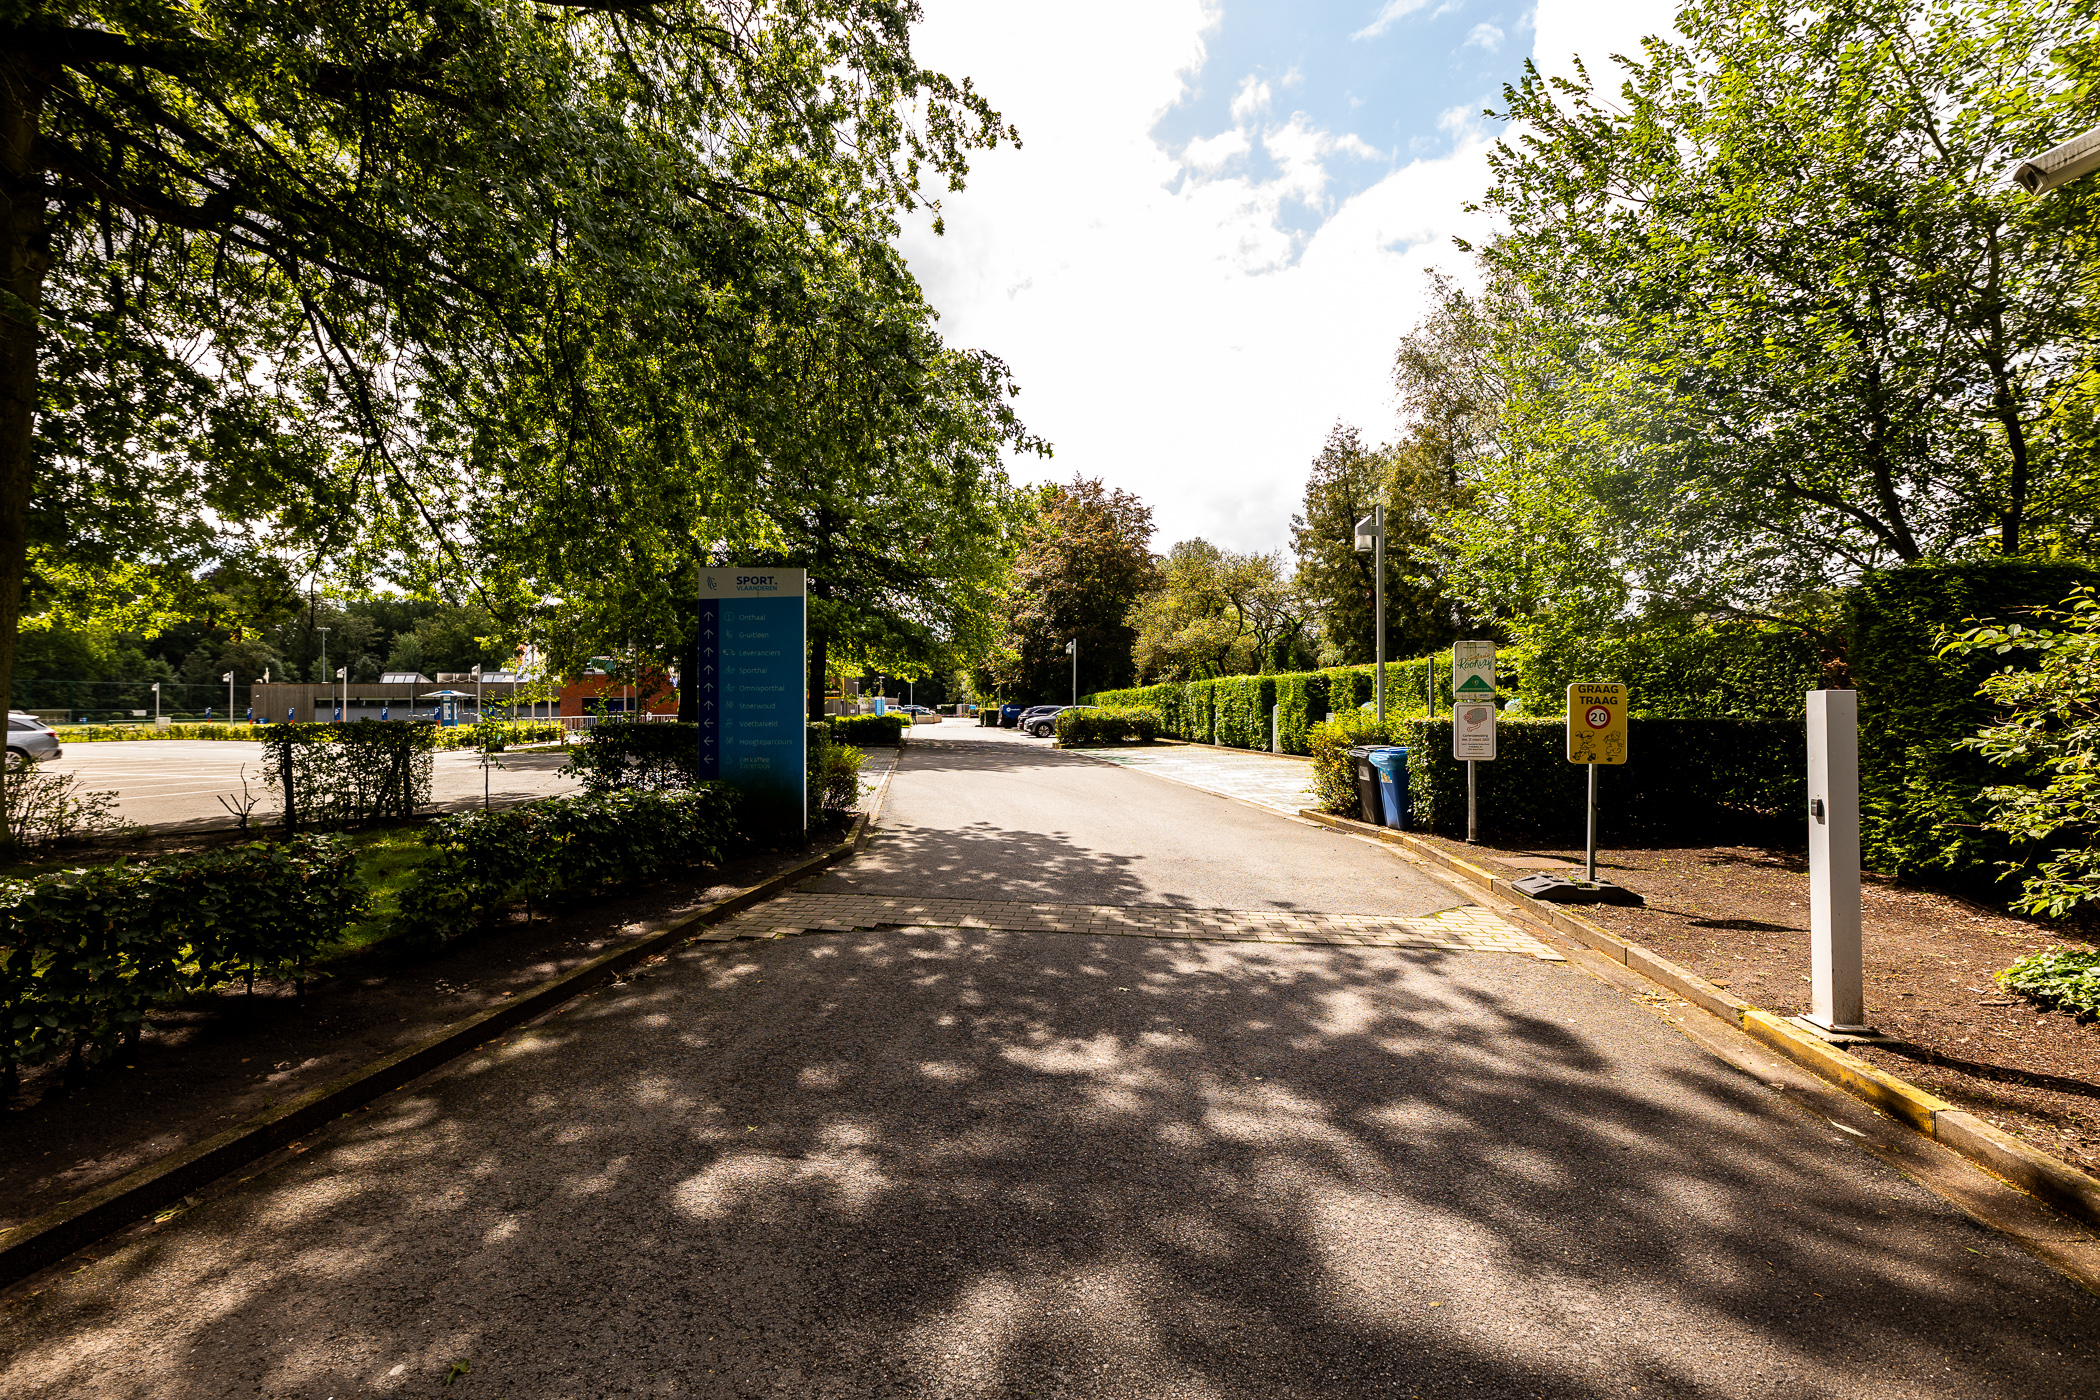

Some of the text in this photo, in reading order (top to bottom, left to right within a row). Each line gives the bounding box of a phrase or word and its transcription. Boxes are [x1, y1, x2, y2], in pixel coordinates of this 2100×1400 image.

[736, 576, 778, 585] SPORT.
[738, 631, 770, 639] G-uitleen
[738, 667, 768, 676] Sporthal
[739, 685, 785, 693] Omnisporthal
[1578, 685, 1618, 693] GRAAG
[1579, 696, 1618, 704] TRAAG
[739, 702, 776, 710] Stoerwoud
[1590, 712, 1606, 722] 20
[739, 720, 778, 728] Voetbalveld
[739, 739, 793, 747] Hoogteparcours
